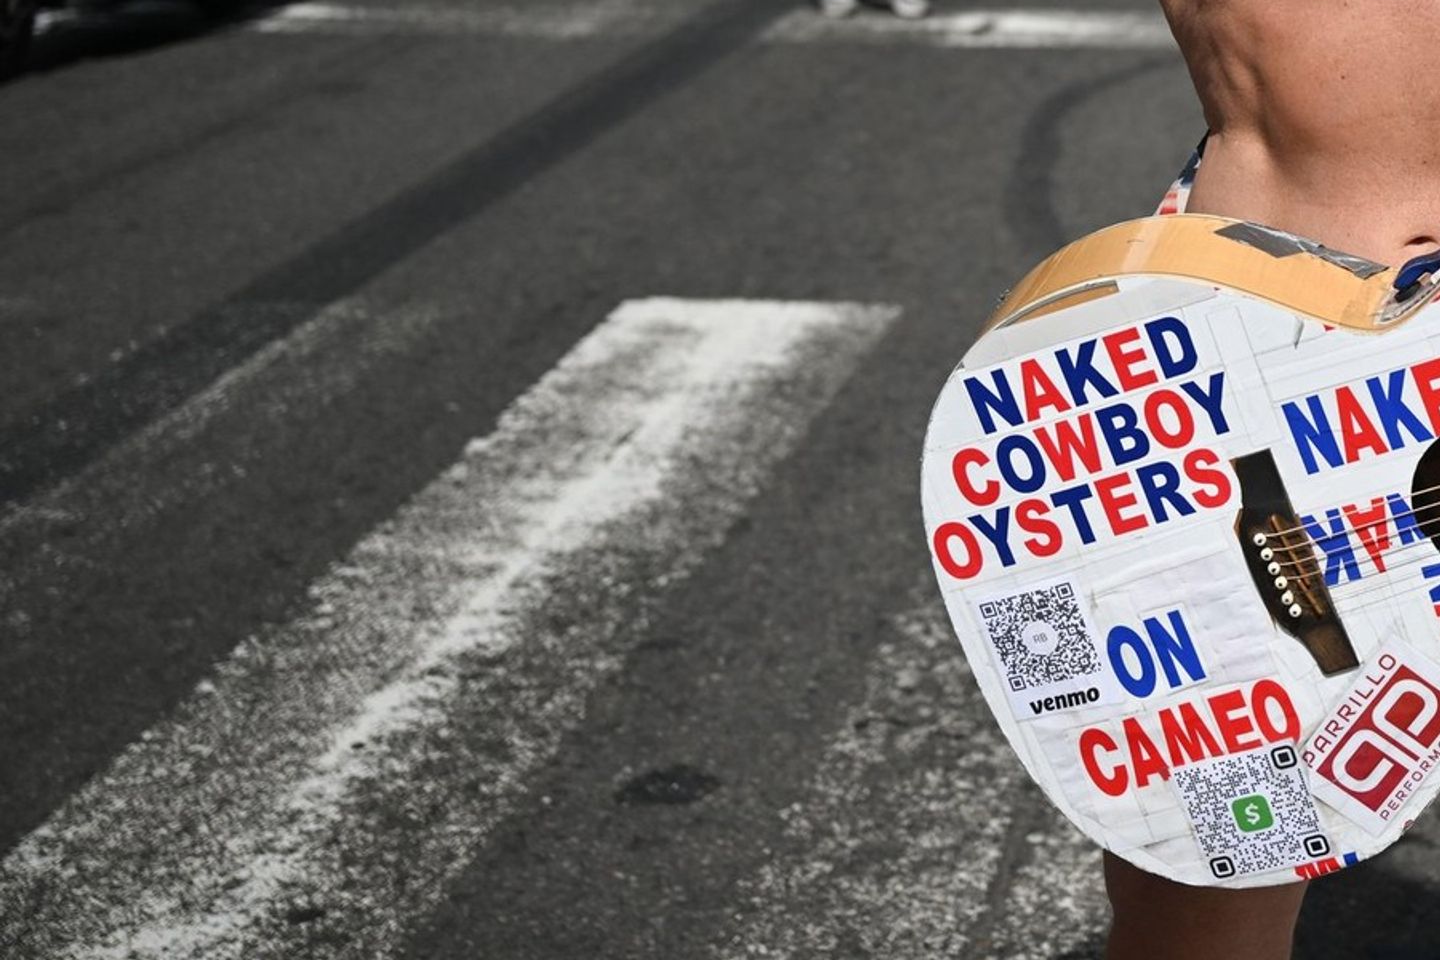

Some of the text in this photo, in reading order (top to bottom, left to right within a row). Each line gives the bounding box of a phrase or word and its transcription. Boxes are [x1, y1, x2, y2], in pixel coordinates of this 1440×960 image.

[963, 317, 1198, 435] NAKED
[952, 372, 1229, 506] COWBOY
[933, 448, 1231, 579] OYSTERS
[1029, 687, 1100, 715] venmo
[1107, 610, 1206, 698] ON
[1302, 654, 1396, 769] PARRILLO
[1079, 679, 1301, 797] CAMEO
